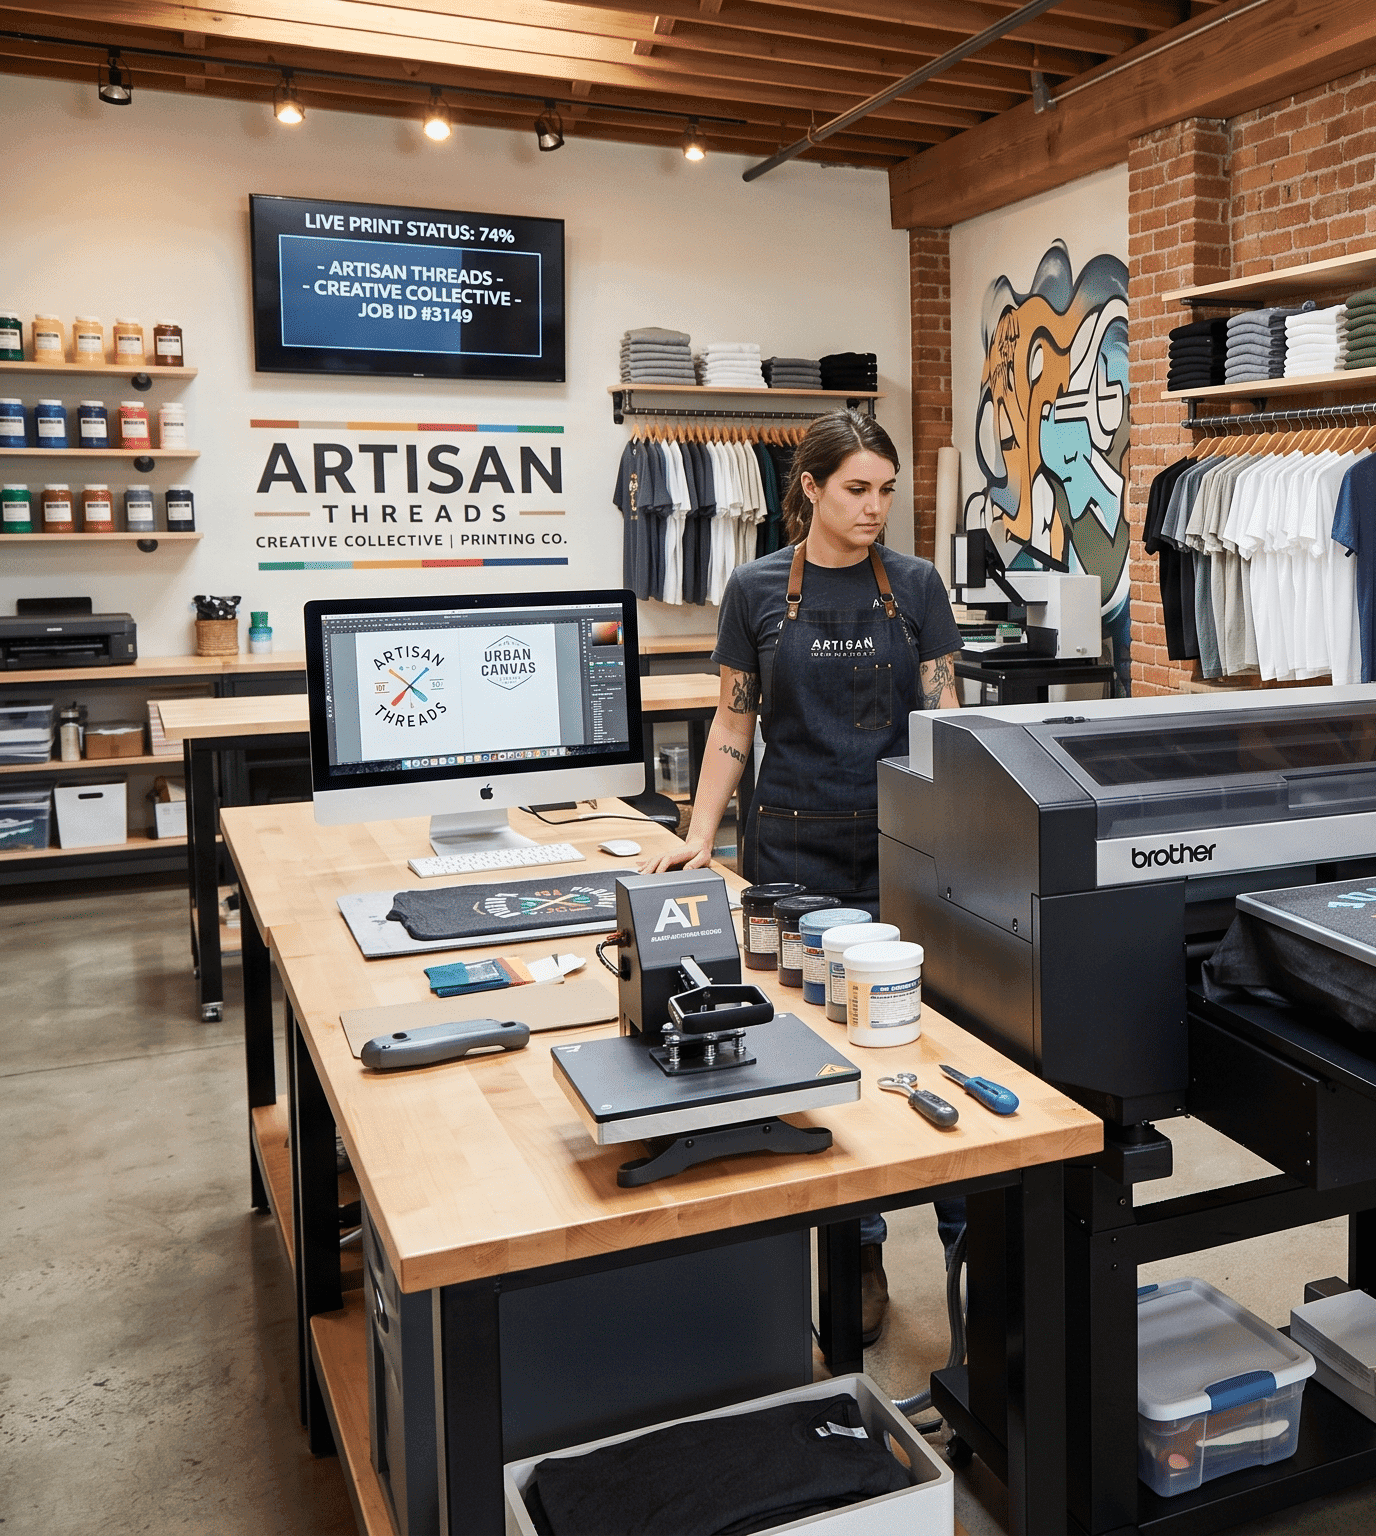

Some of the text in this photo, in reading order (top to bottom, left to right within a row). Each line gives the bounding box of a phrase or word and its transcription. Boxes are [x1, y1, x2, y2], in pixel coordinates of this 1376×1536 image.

[305, 212, 516, 244] LIVE PRINT STATUS: 74%
[328, 260, 407, 281] ARTISAN
[410, 265, 493, 286] THREADS
[313, 280, 402, 301] CREATIVE
[405, 285, 511, 307] COLLECTIVE
[358, 303, 473, 324] JOB ID #3149
[256, 442, 563, 494] ARTISAN
[322, 504, 506, 524] THREADS
[256, 535, 338, 549] CREATIVE
[344, 534, 443, 547] COLLECTIVE
[461, 533, 535, 546] PRINTING
[541, 533, 568, 545] CO.
[373, 645, 445, 671] ARTISAN
[484, 648, 531, 662] URBAN
[481, 661, 536, 677] CANVAS
[374, 701, 447, 728] THREADS
[1131, 842, 1217, 869] brother
[653, 894, 709, 933] AT
